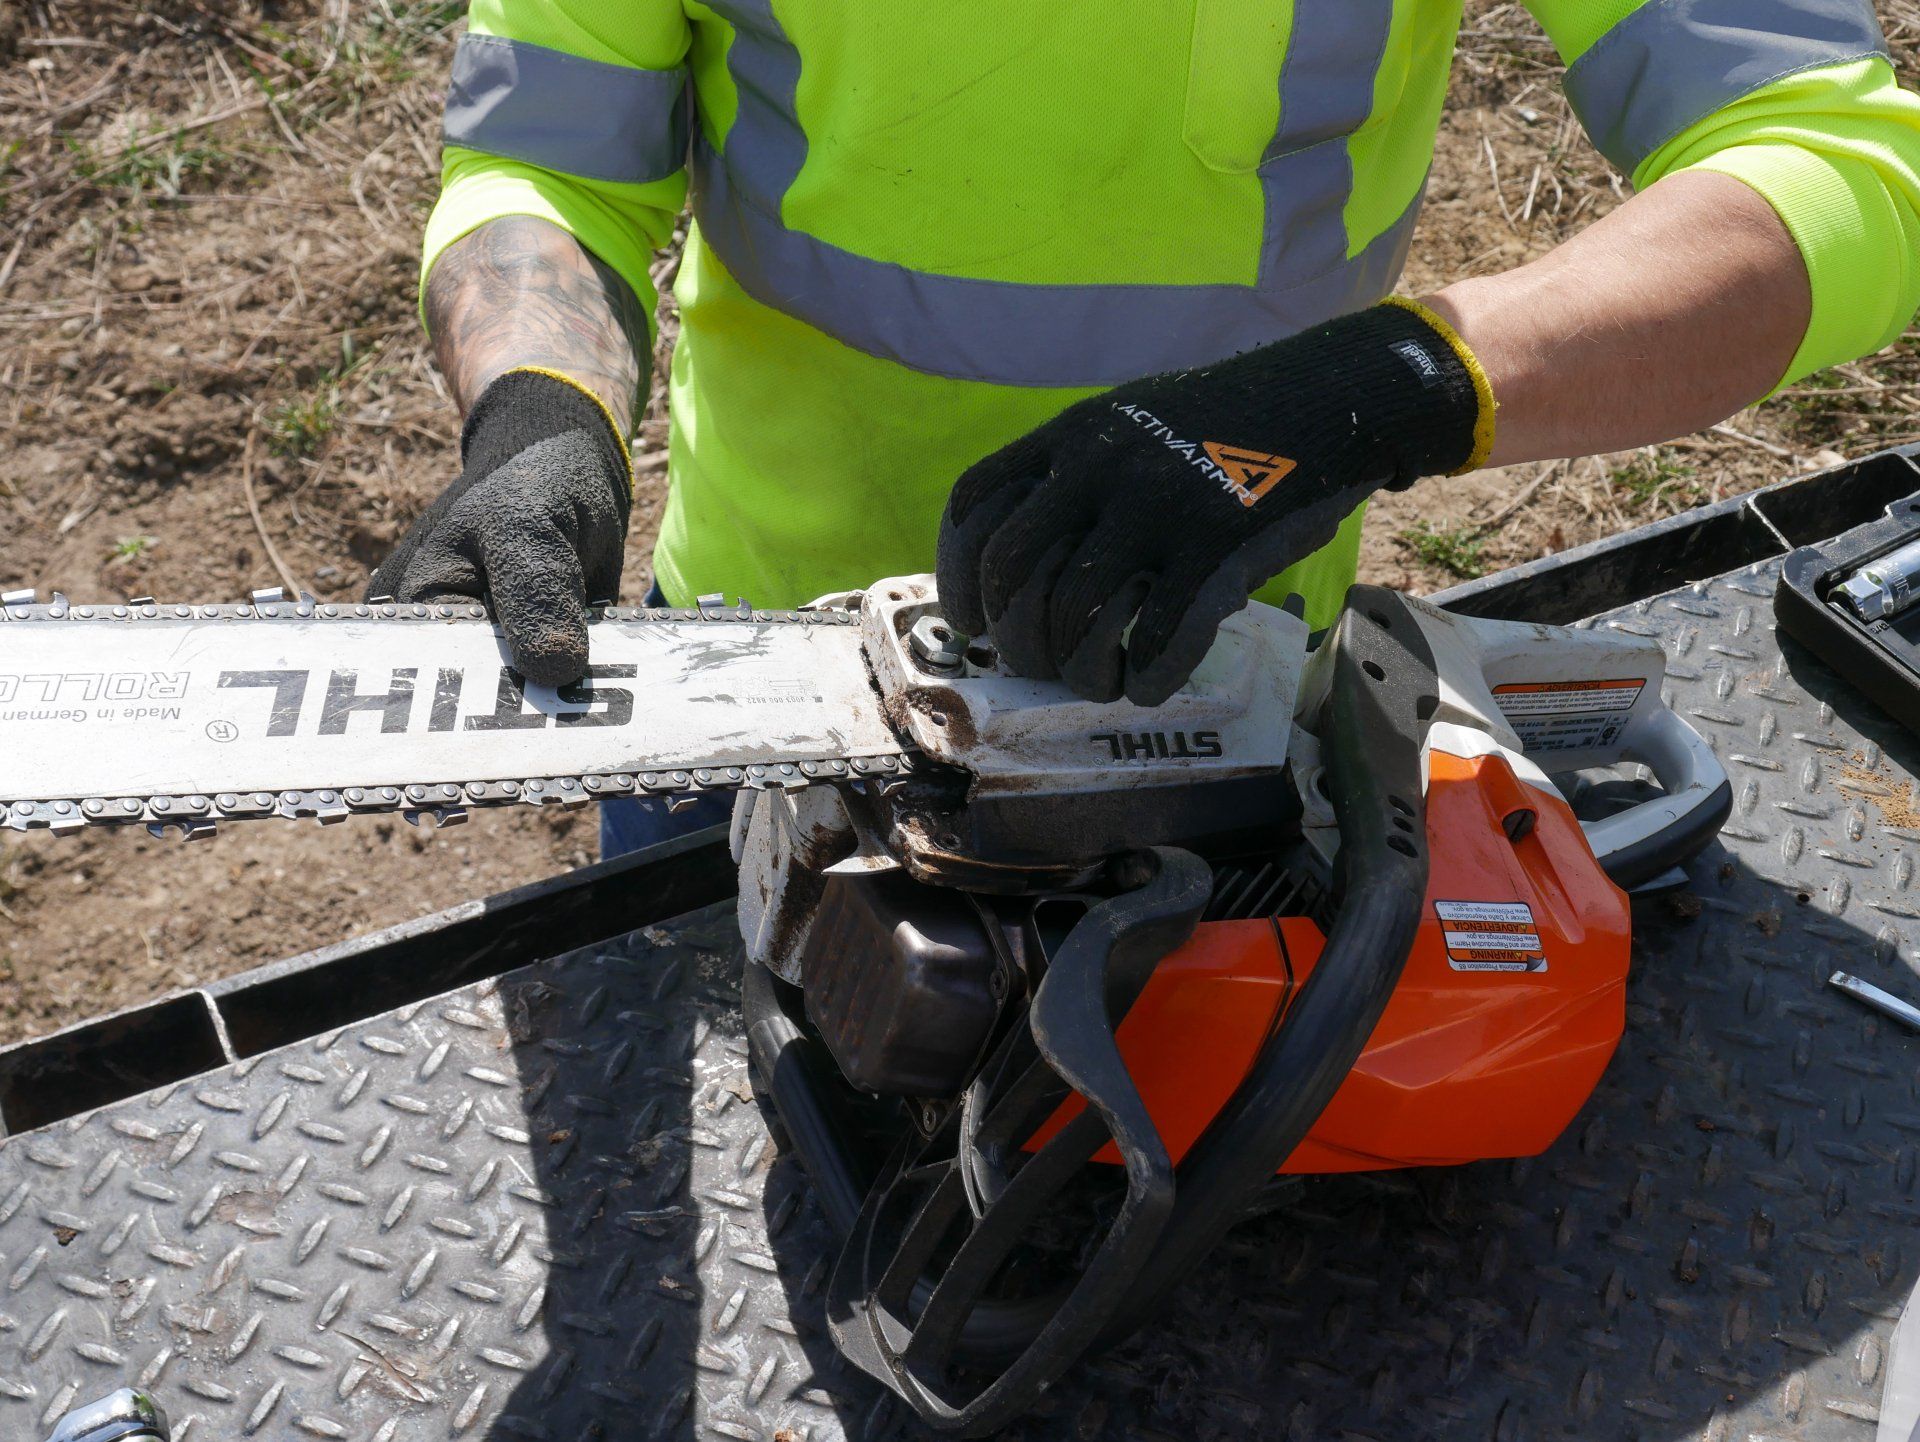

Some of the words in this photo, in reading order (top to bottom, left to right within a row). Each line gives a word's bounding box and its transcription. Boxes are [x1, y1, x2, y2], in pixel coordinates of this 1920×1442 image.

[1400, 344, 1436, 375] Ansell
[216, 664, 638, 737] STIHL
[97, 709, 114, 721] in
[123, 708, 181, 720] Made
[1090, 731, 1223, 761] STIHL
[1453, 922, 1518, 932] ADVERTENCIA
[1471, 940, 1508, 948] Reproductive
[1470, 950, 1514, 959] WARNING
